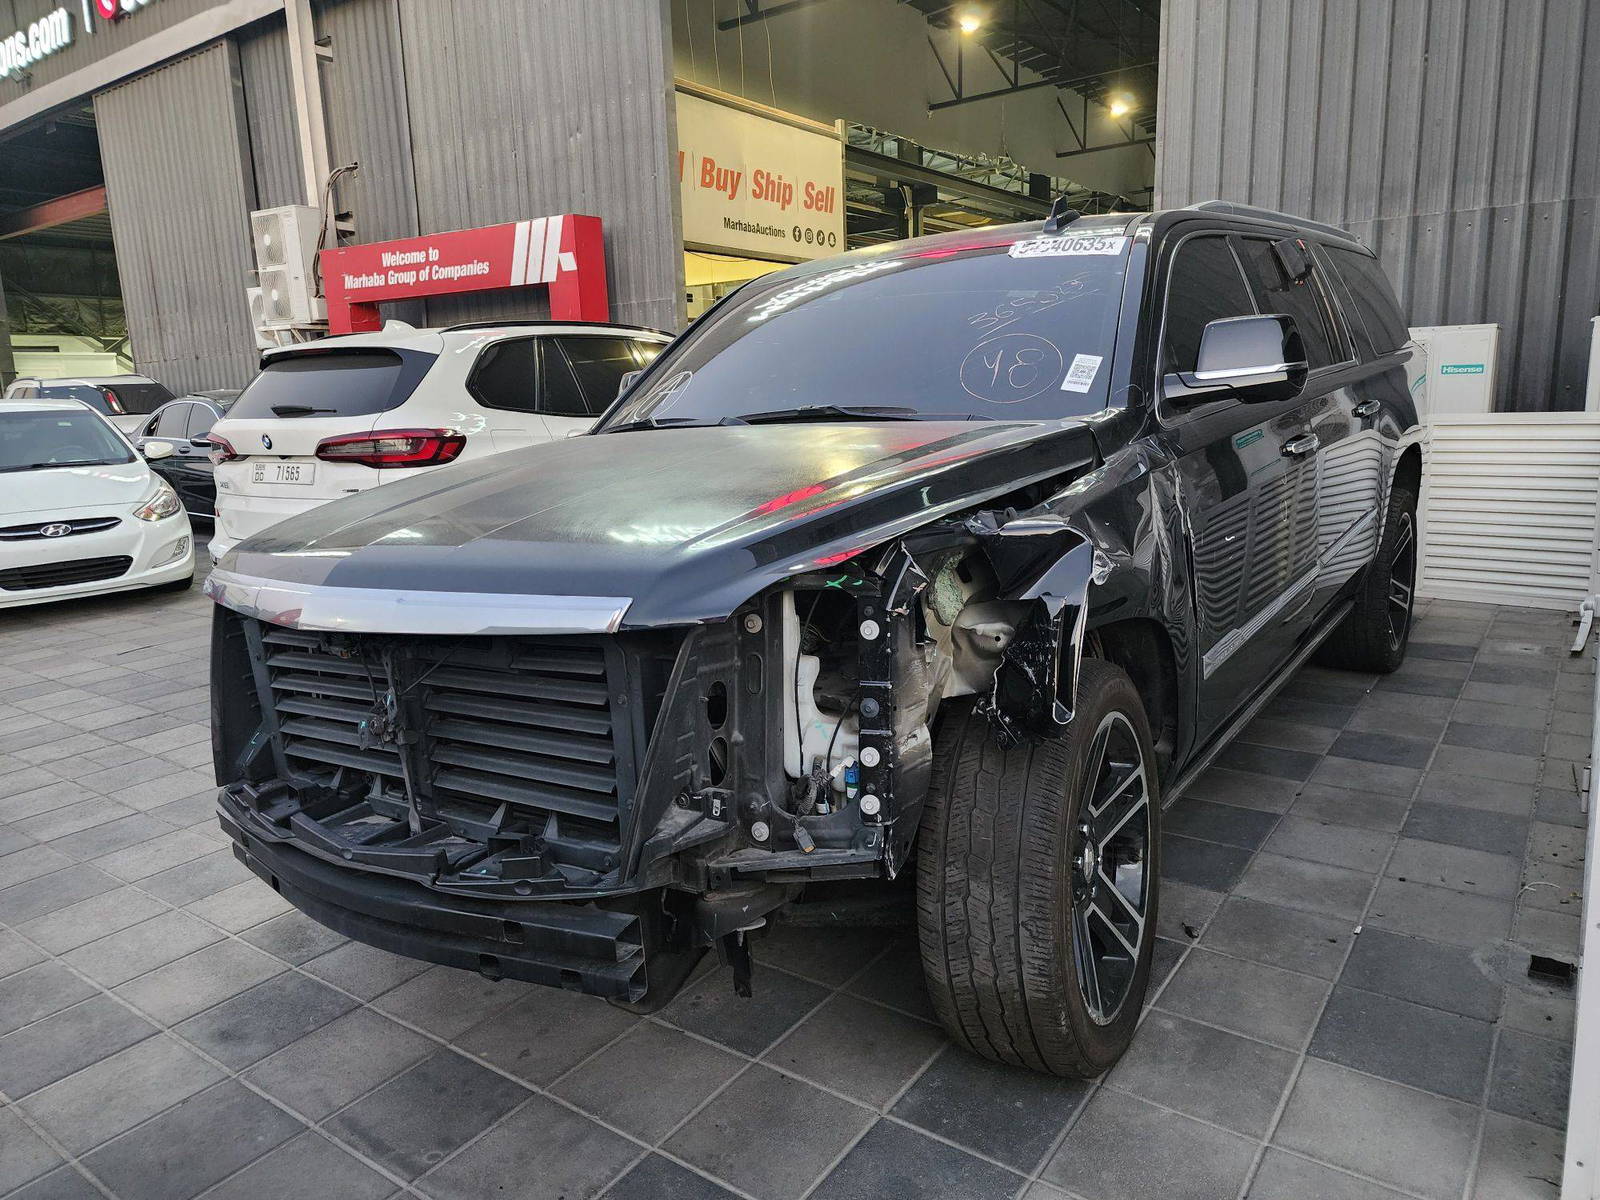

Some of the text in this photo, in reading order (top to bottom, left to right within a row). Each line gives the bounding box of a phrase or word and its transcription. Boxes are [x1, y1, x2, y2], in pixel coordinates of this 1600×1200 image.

[700, 156, 742, 201] Buy
[752, 169, 793, 211] Ship
[803, 181, 835, 214] Sell
[723, 217, 786, 239] MarhabaAuctions
[381, 247, 440, 268] Welcome to
[344, 259, 490, 290] Marhaba Group of Companies
[1442, 365, 1483, 374] Hisense
[277, 465, 300, 481] 71565
